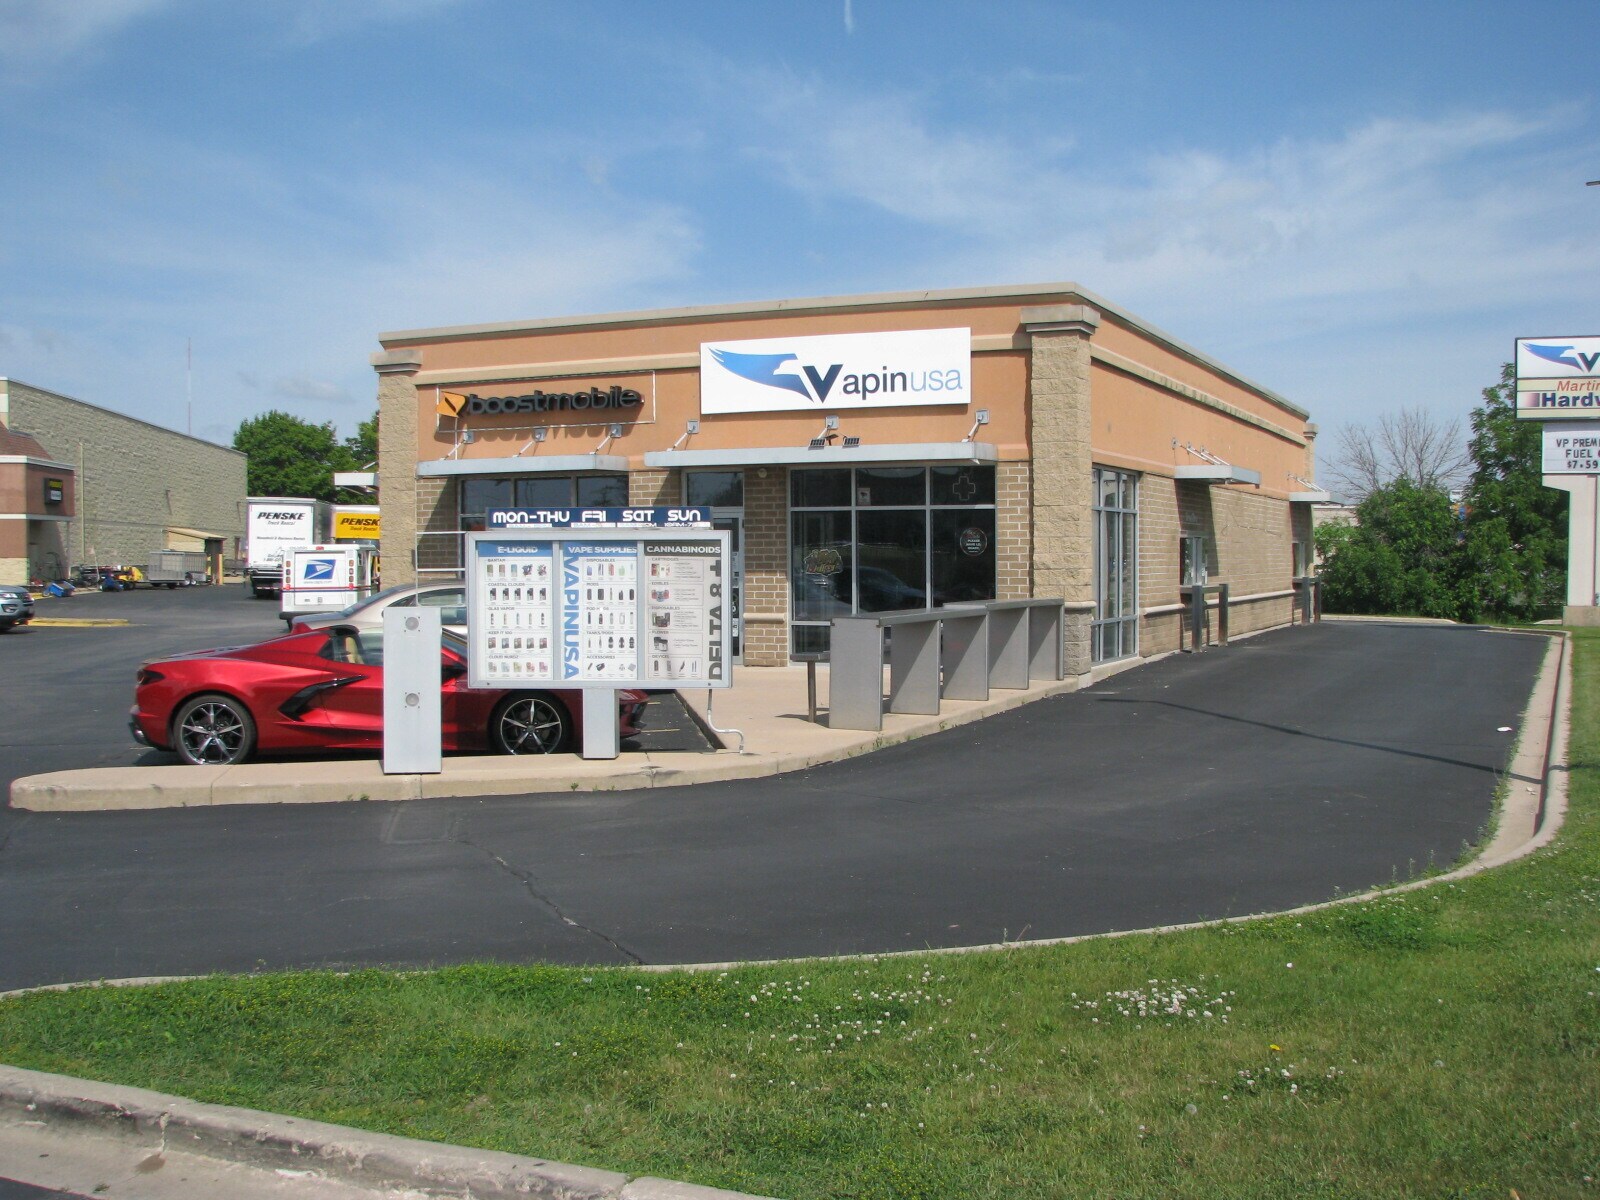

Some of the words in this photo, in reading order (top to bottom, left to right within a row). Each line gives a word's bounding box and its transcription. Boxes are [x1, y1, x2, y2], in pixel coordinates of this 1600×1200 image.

[1556, 438, 1569, 448] VP
[1565, 449, 1593, 458] FUEL
[1567, 460, 1599, 469] $7.59
[257, 512, 306, 520] PENSKE
[582, 510, 607, 522] FRI
[667, 509, 701, 522] SUN
[341, 517, 380, 526] PENSK
[497, 546, 538, 554] E-LIQUID
[568, 546, 593, 554] VAPE
[594, 546, 637, 554] SUPPLIES
[646, 545, 721, 554] CANNABINOIDS
[563, 556, 580, 680] VAPINUSA
